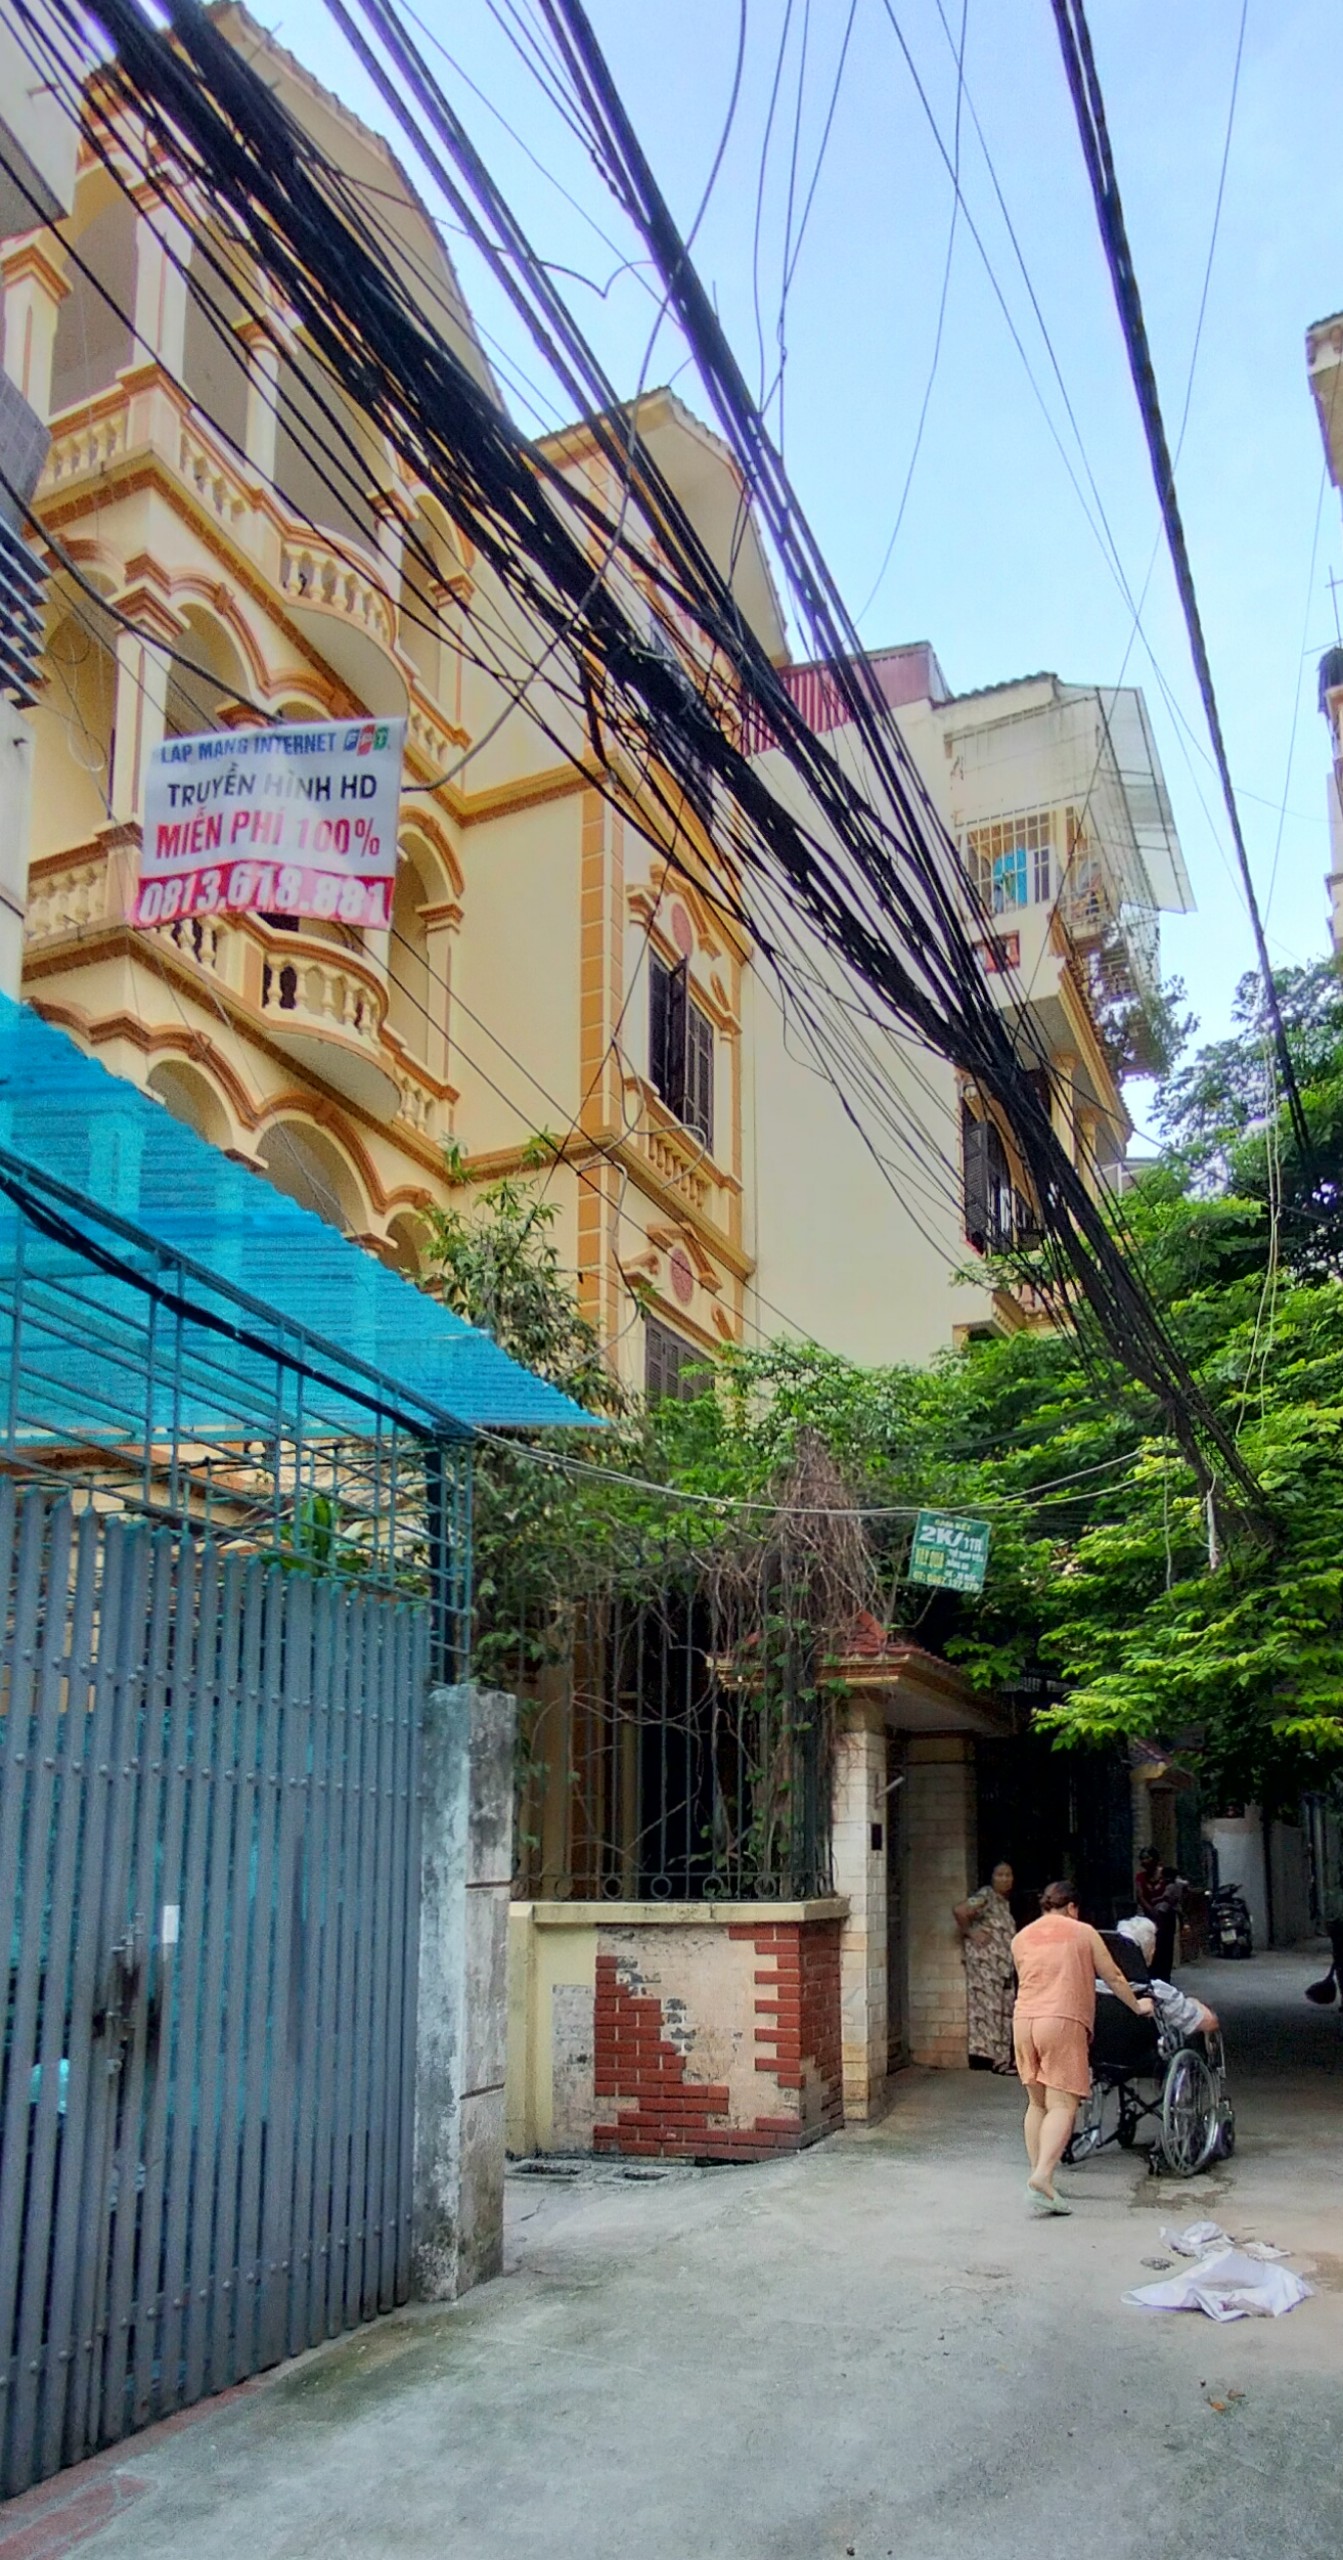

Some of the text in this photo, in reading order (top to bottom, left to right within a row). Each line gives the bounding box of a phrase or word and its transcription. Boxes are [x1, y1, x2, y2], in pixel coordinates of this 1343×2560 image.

[254, 732, 337, 754] INTERNET
[168, 762, 378, 808] TRUYỀN HÌNH HD
[156, 806, 381, 860] MIỄN PHÍ 100%
